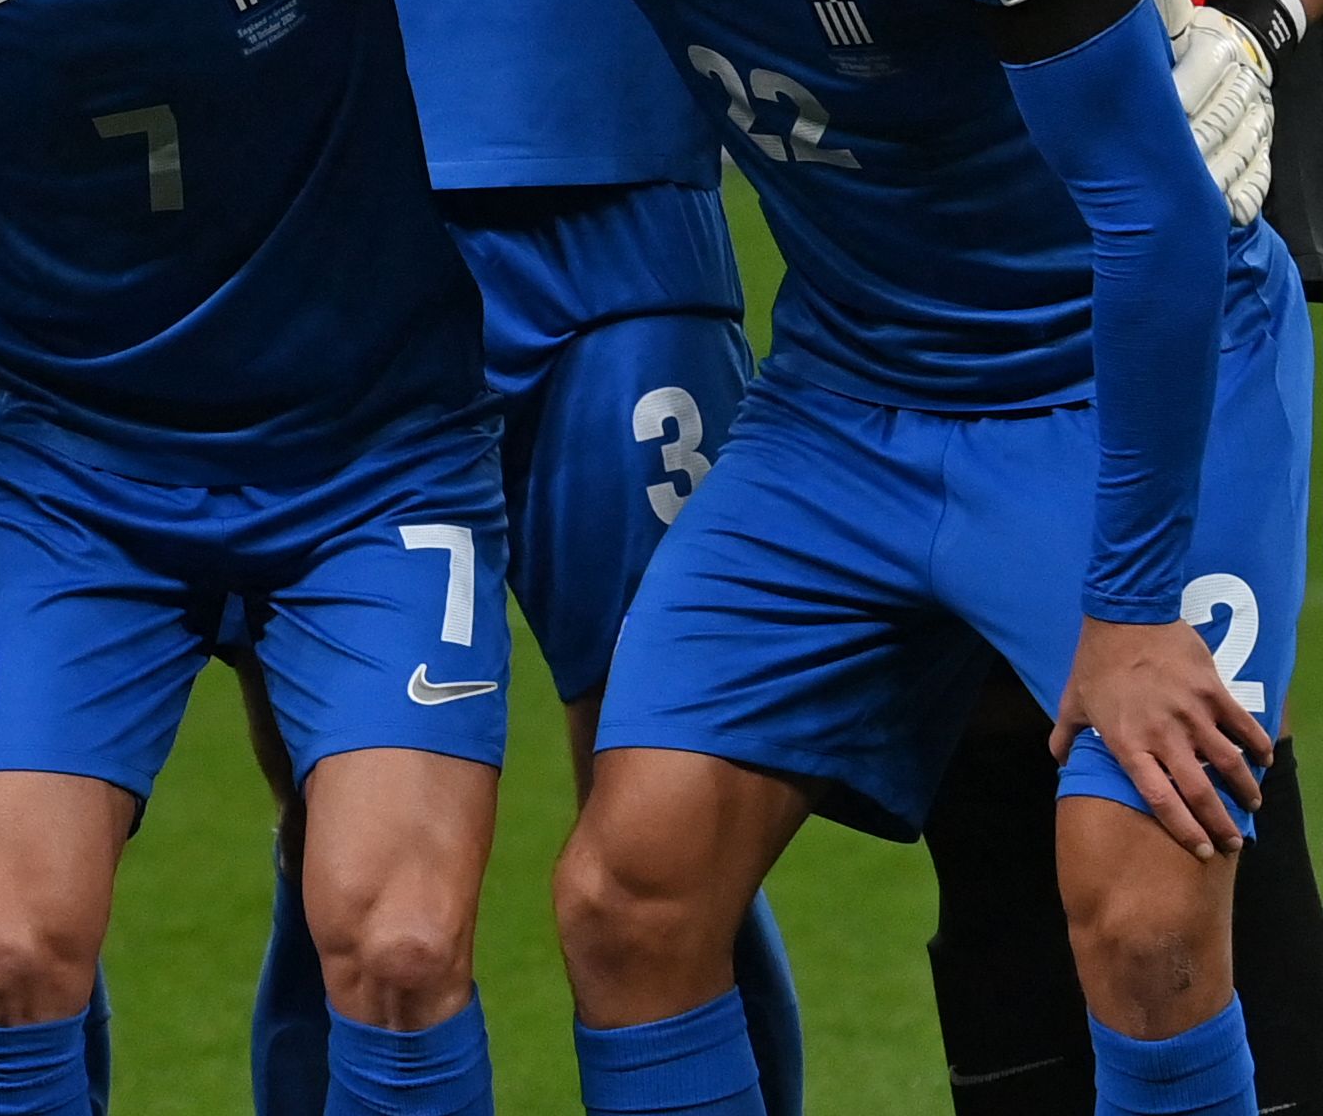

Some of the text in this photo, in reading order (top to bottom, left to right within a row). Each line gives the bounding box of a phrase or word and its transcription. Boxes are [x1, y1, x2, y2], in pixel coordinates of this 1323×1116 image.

[93, 104, 184, 212] 7
[687, 45, 862, 169] 22
[631, 386, 712, 525] 3
[398, 525, 473, 647] 7
